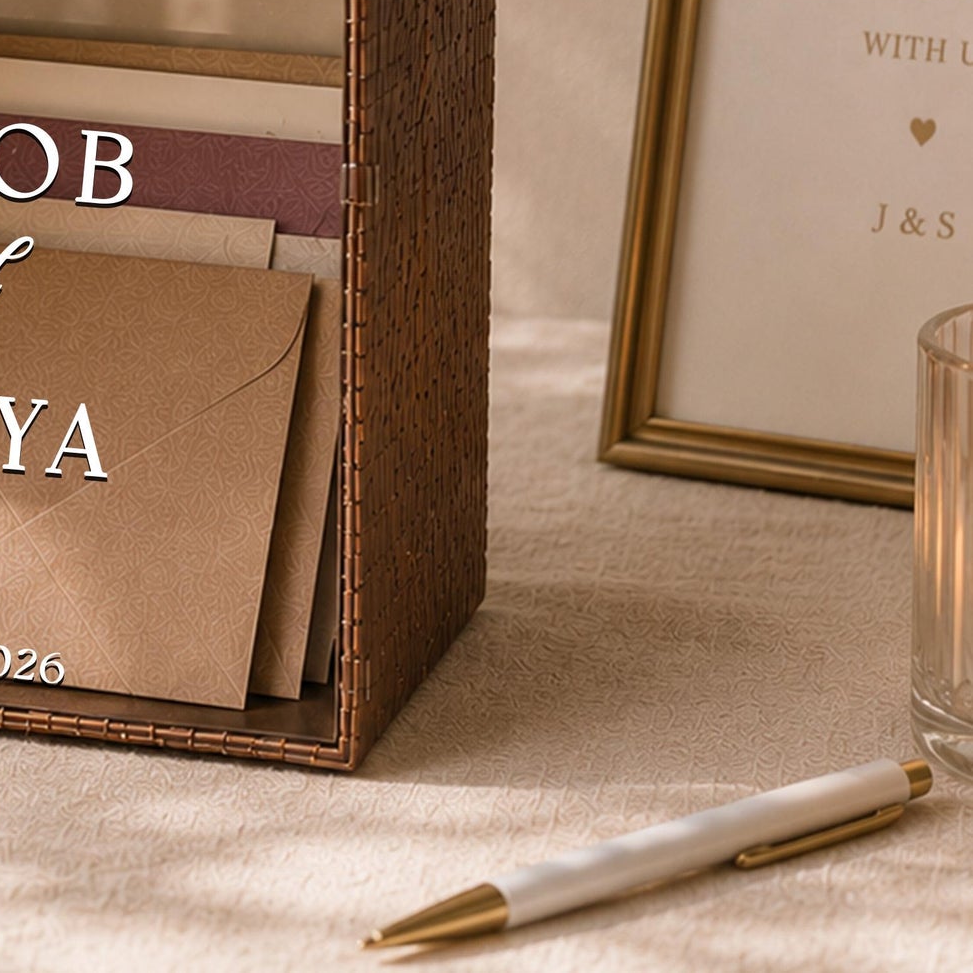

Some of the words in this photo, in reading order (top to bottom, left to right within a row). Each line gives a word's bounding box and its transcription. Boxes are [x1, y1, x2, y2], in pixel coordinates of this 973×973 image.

[863, 30, 947, 63] WITH
[872, 203, 888, 233] J
[899, 207, 927, 238] &
[937, 210, 956, 240] S
